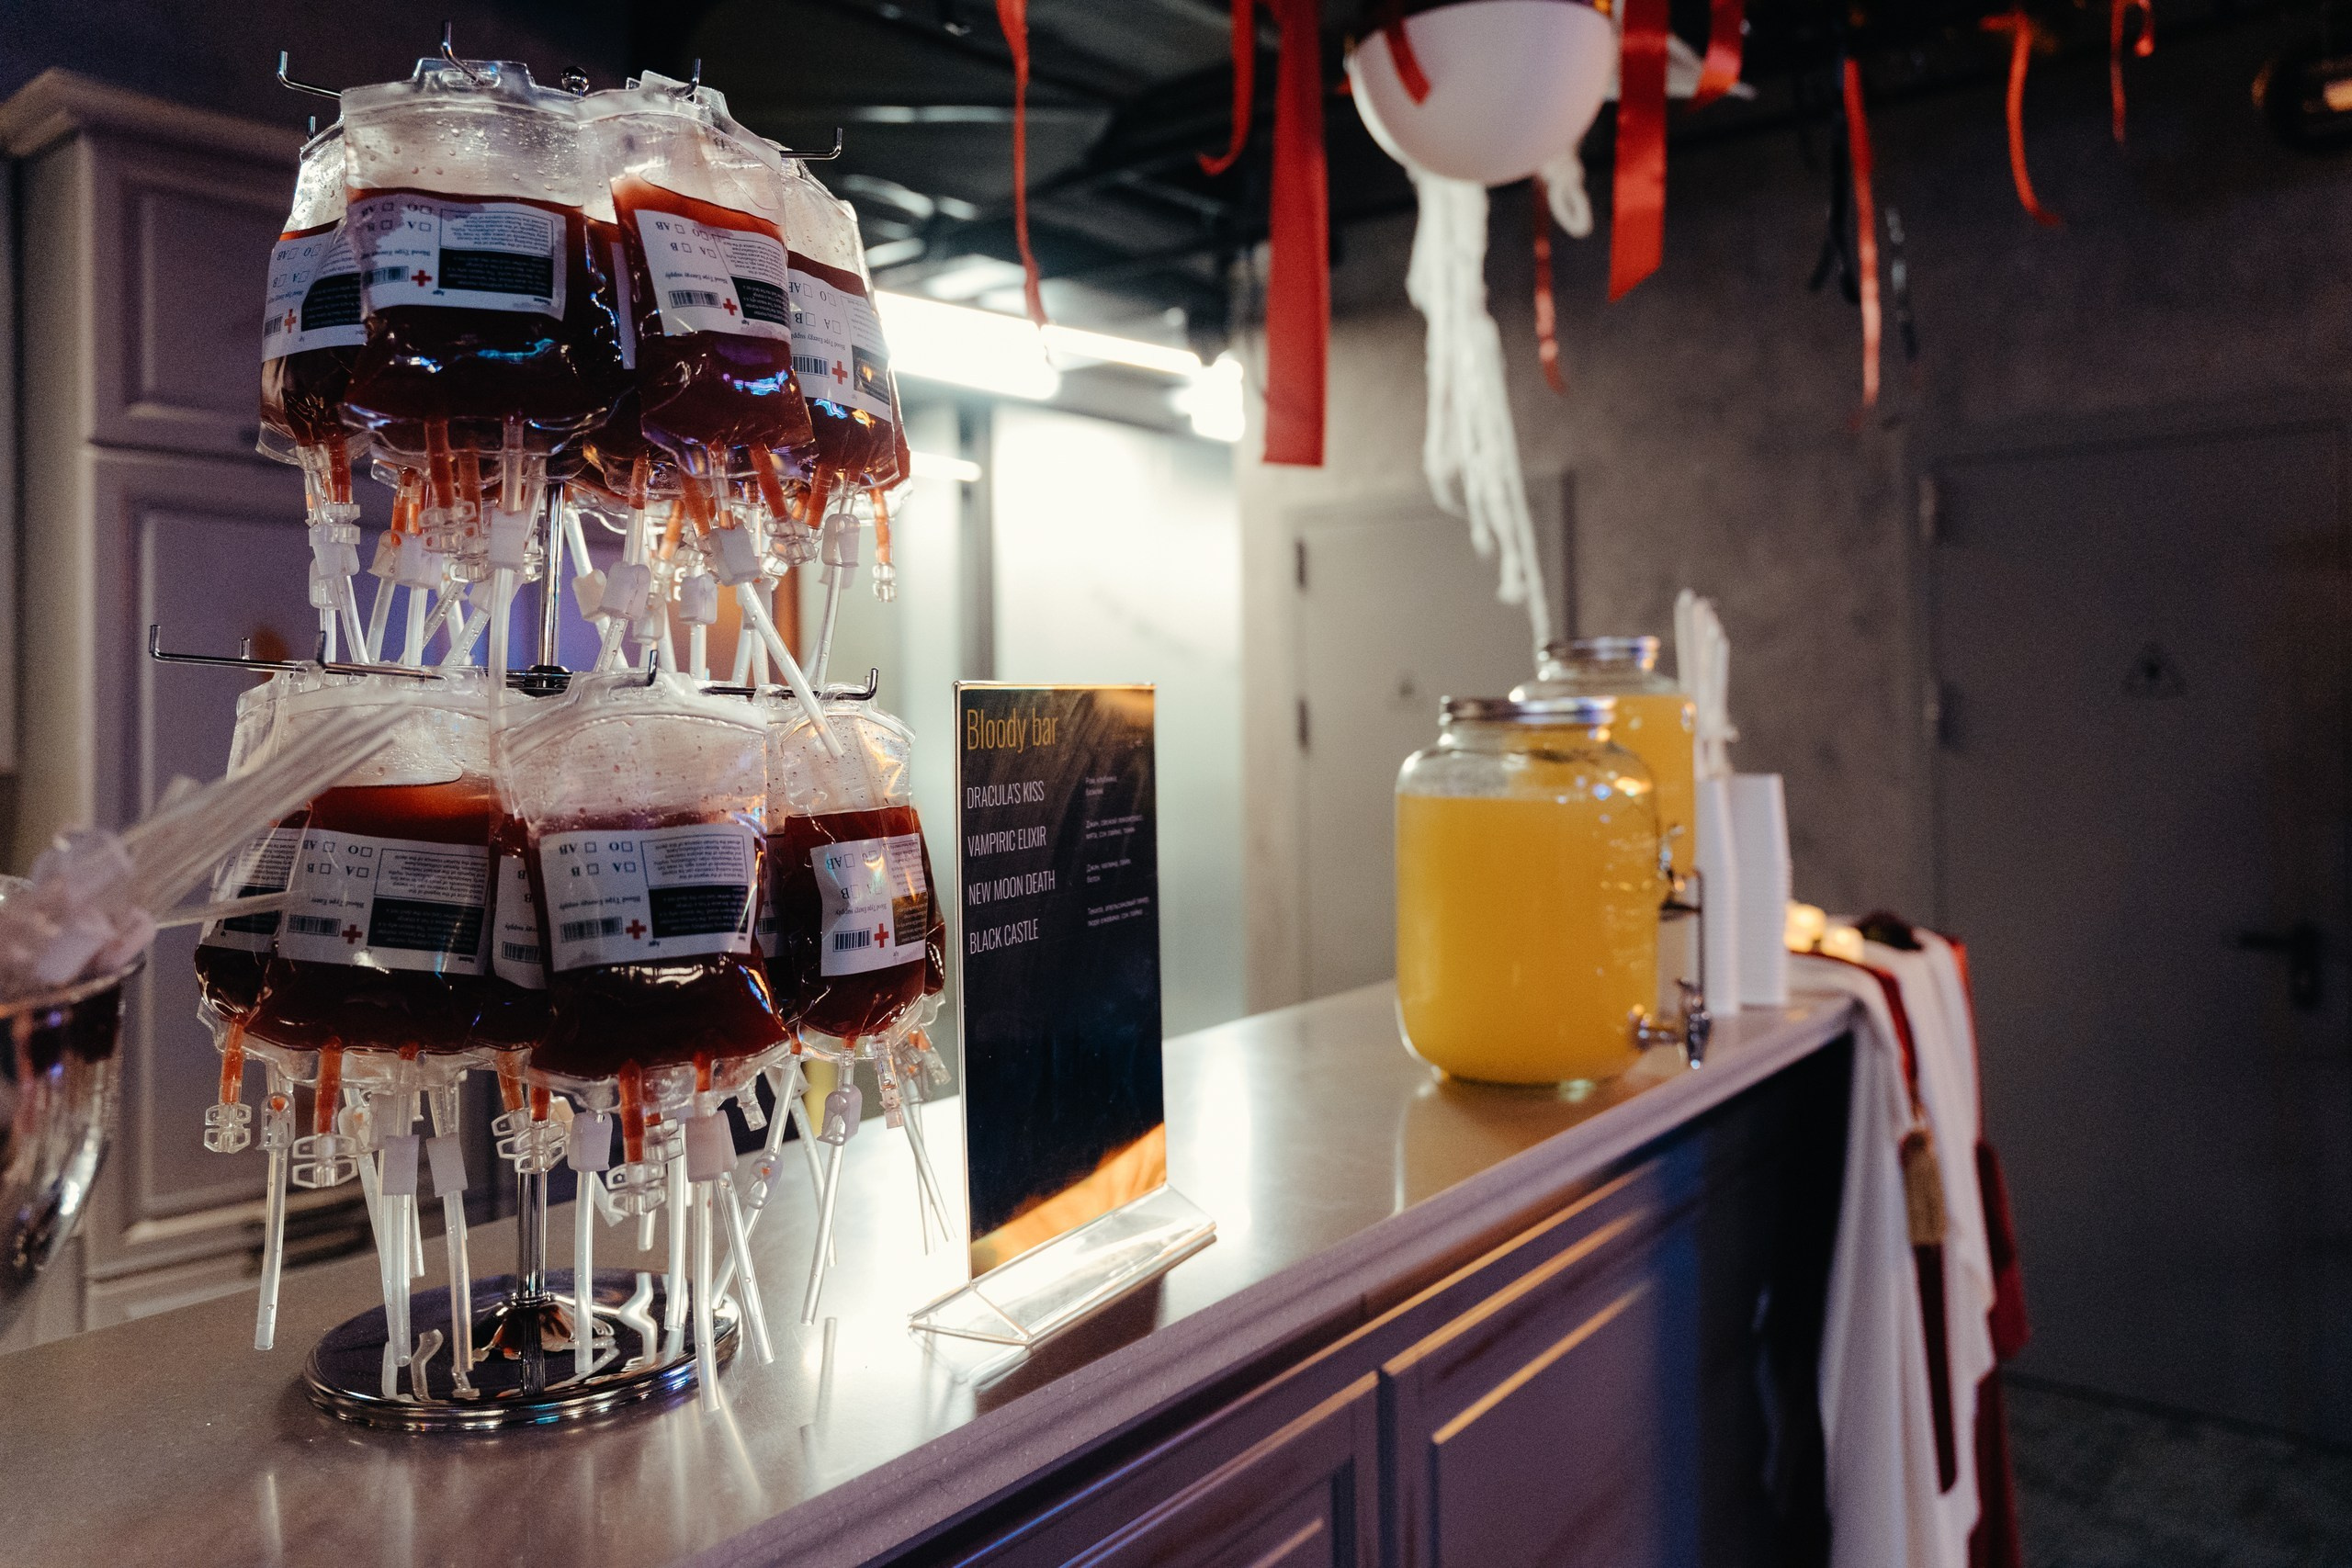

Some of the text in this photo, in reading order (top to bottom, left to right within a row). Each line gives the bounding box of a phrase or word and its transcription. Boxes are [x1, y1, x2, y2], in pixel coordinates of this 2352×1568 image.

[407, 220, 416, 229] A
[655, 221, 671, 230] AB
[277, 247, 311, 260] O AB
[670, 243, 707, 255] A B
[273, 274, 299, 288] A B
[684, 272, 701, 280] Energy
[820, 290, 826, 301] O
[795, 313, 831, 329] A B
[791, 333, 845, 350] Blood Type Energy suppl
[967, 707, 1058, 754] Bloody bar
[967, 781, 1045, 809] DRACULA'S KISS
[303, 840, 358, 854] O AB
[559, 841, 619, 854] O AB
[967, 826, 1047, 858] VAMPIRIC ELIXIR
[307, 863, 355, 877] A B
[571, 863, 622, 876] A B
[826, 857, 842, 870] AB
[517, 870, 526, 880] B
[841, 884, 874, 899] A B
[968, 870, 1056, 906] NEW MOON DEATH
[329, 899, 343, 908] Type
[524, 893, 531, 903] B
[605, 897, 620, 905] Type
[622, 896, 640, 904] Blood
[867, 904, 876, 912] Type
[969, 919, 1039, 954] BLACK CASTLE
